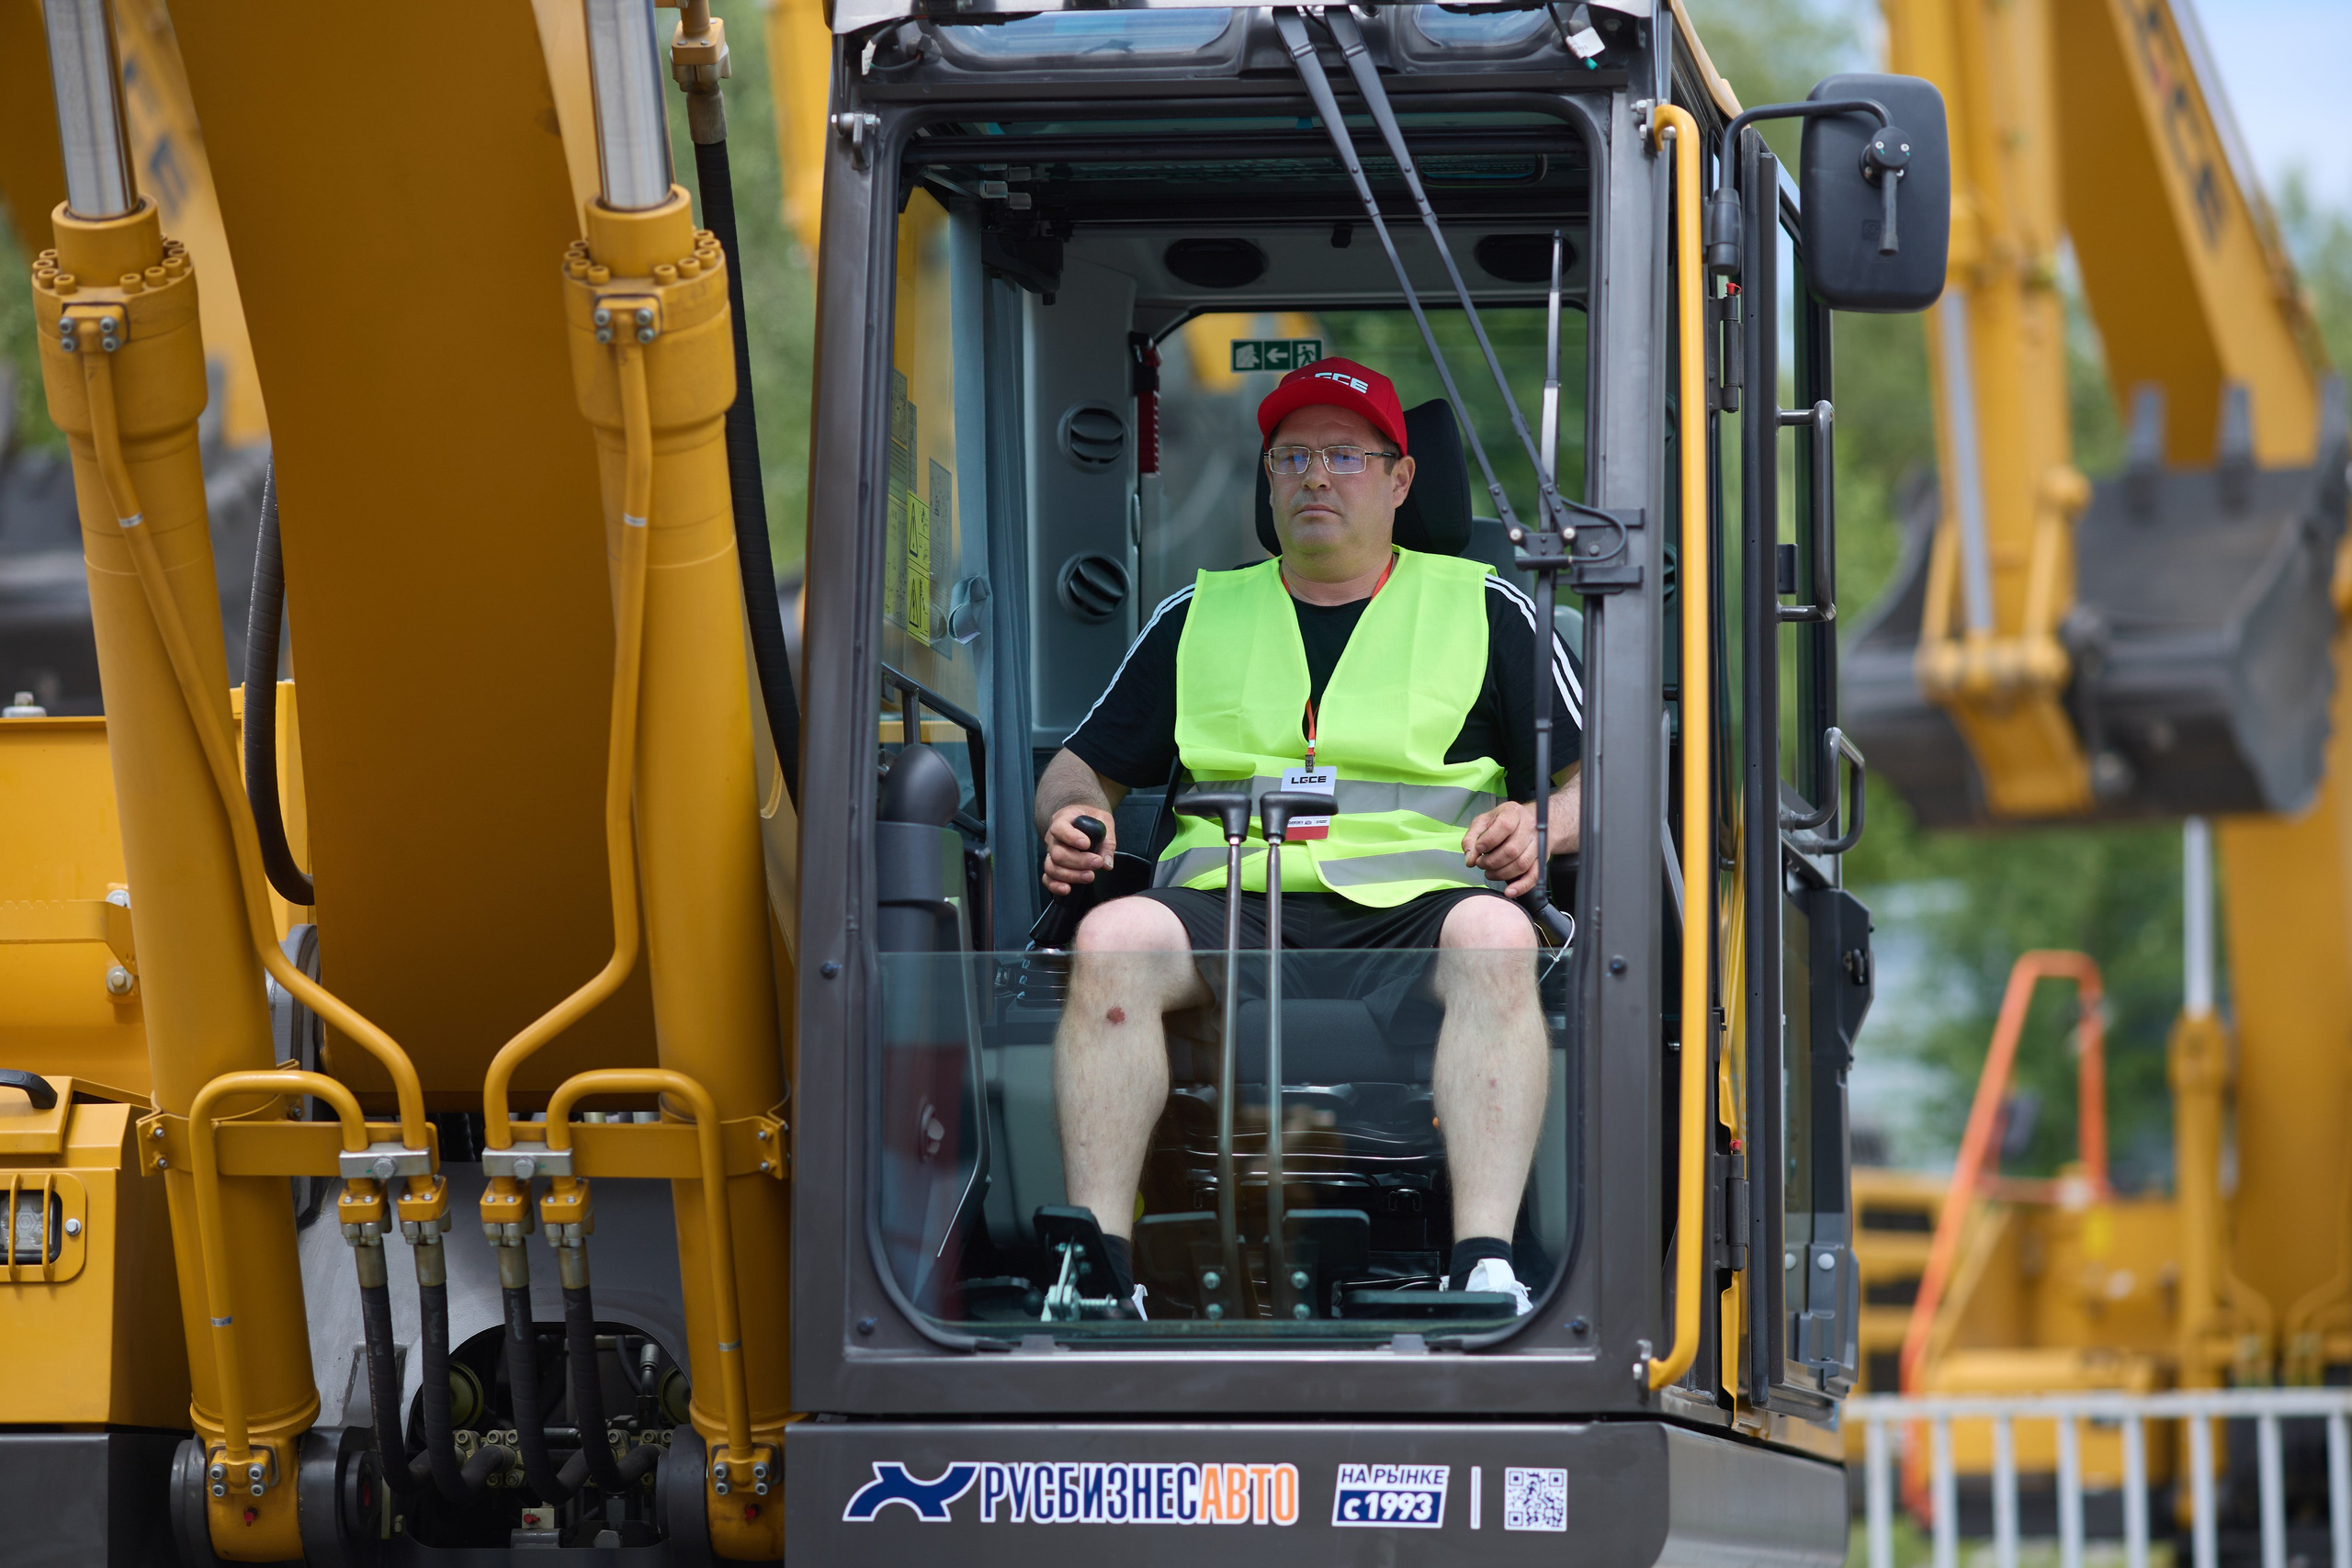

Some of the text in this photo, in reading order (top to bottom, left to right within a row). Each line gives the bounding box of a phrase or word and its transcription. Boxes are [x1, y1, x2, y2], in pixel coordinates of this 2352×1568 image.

[1291, 775, 1328, 784] LGCE
[1374, 1468, 1446, 1484] РЫНКЕ
[983, 1464, 1296, 1522] РУСБИЗНЕСАВТО
